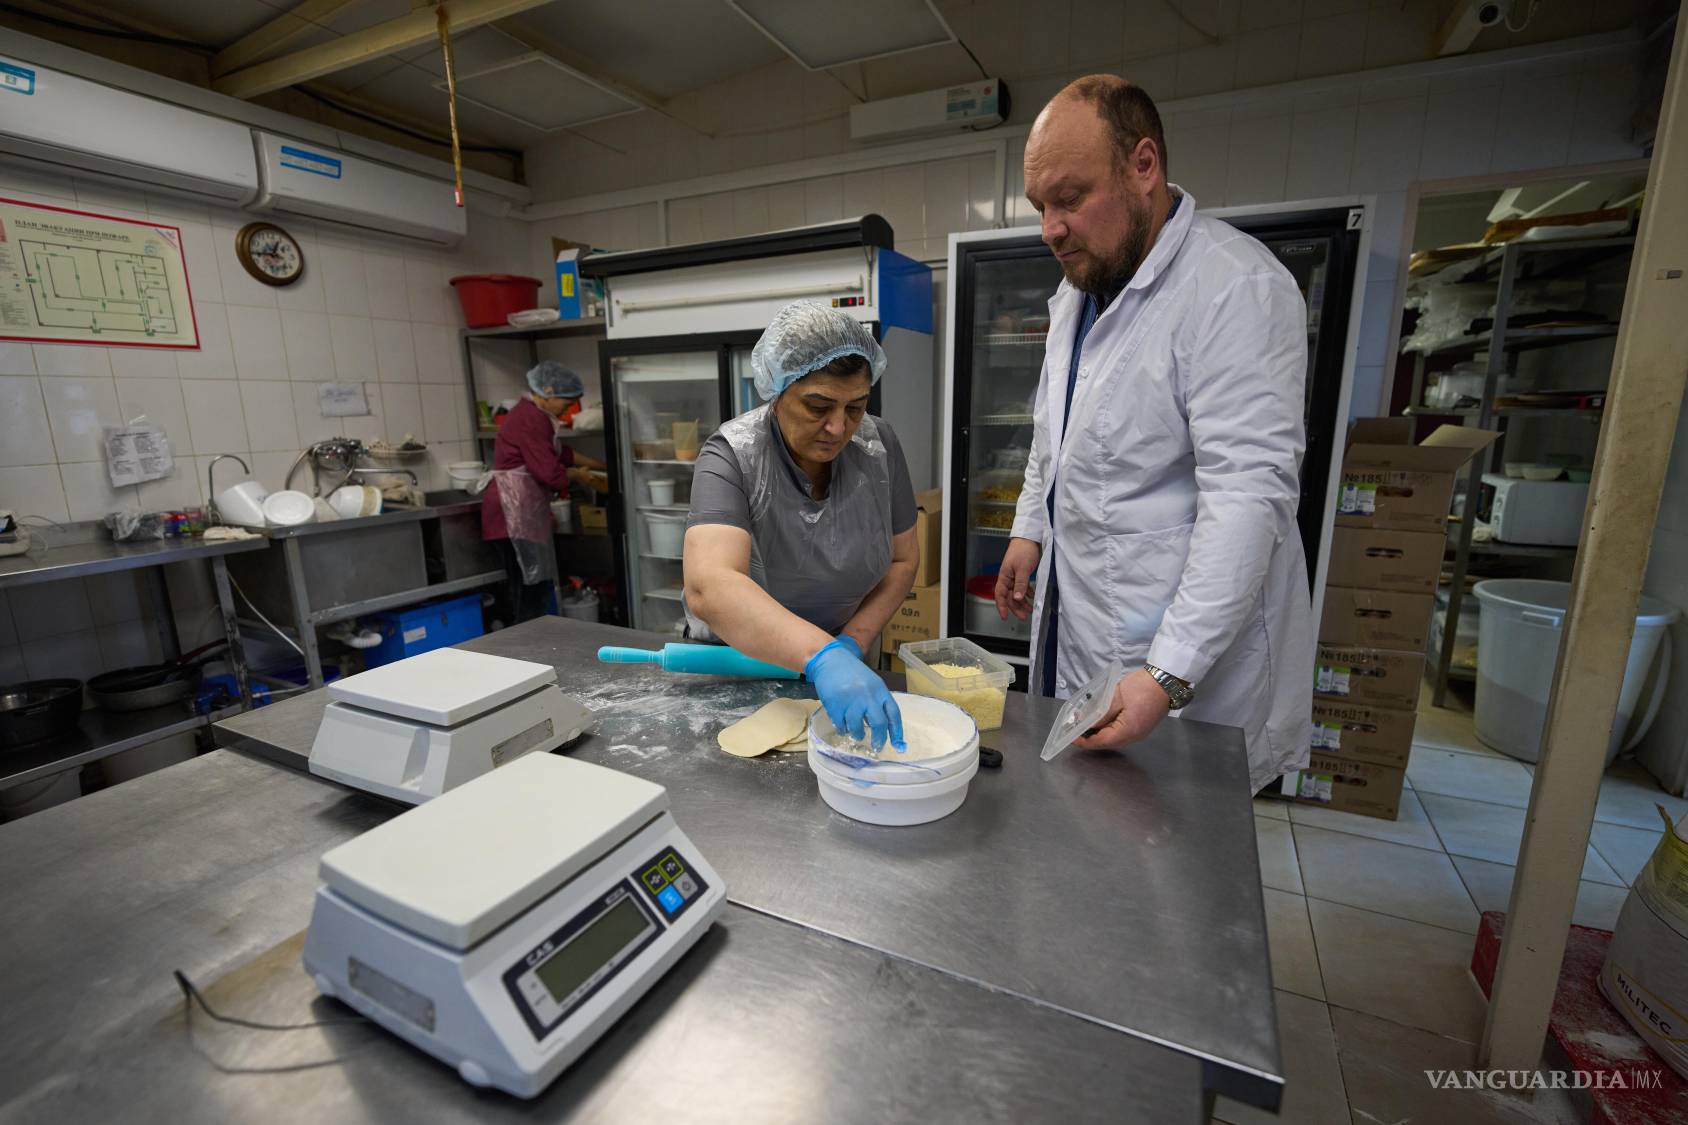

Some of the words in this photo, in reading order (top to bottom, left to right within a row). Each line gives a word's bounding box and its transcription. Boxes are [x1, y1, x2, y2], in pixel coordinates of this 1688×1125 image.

[1352, 214, 1362, 227] 7
[526, 940, 555, 967] CAS
[1617, 973, 1672, 1035] MILITEC
